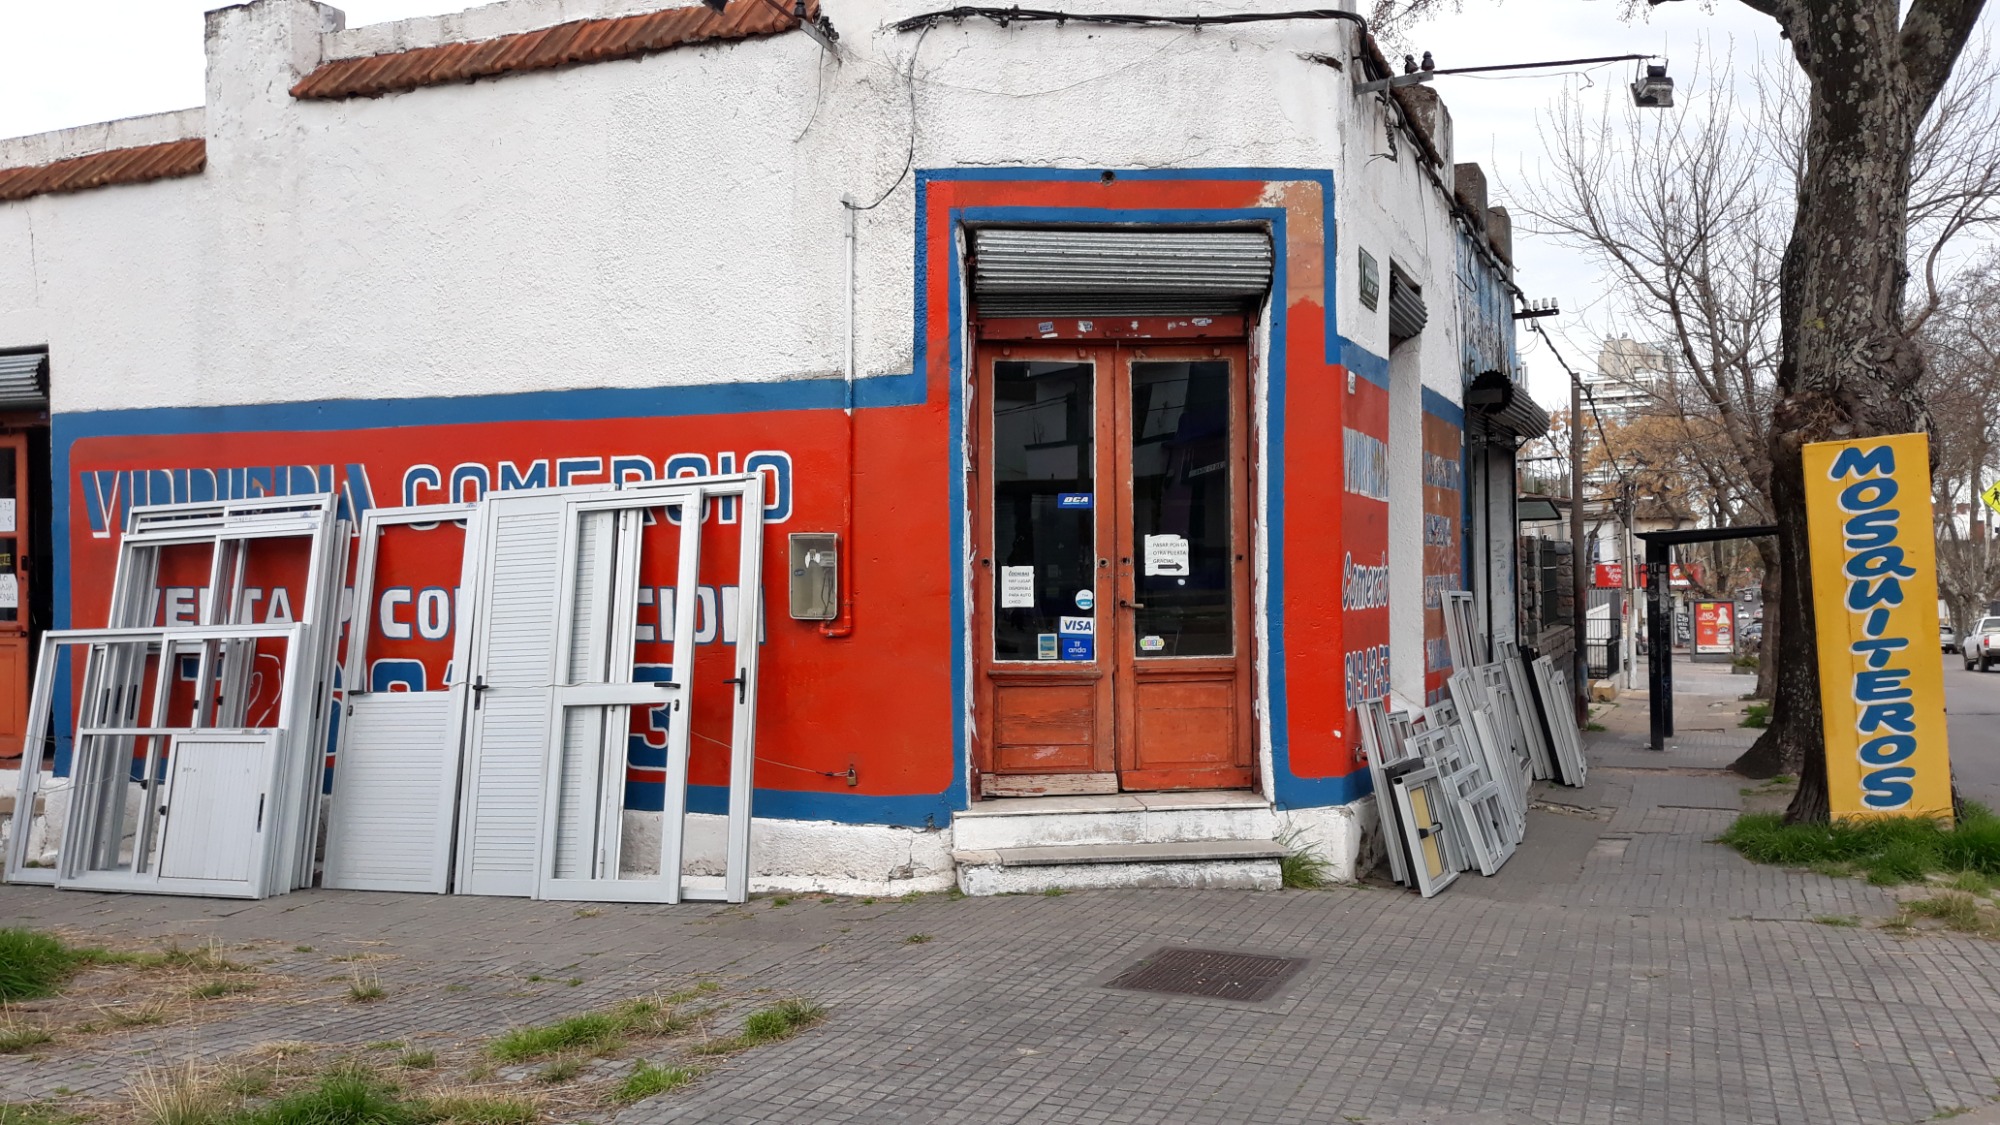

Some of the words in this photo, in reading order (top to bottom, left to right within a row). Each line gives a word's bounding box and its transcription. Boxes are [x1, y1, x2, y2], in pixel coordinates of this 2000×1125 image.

[1342, 551, 1389, 611] Comercio
[1064, 620, 1092, 631] VISA
[1827, 445, 1916, 811] MOSQUITEROS
